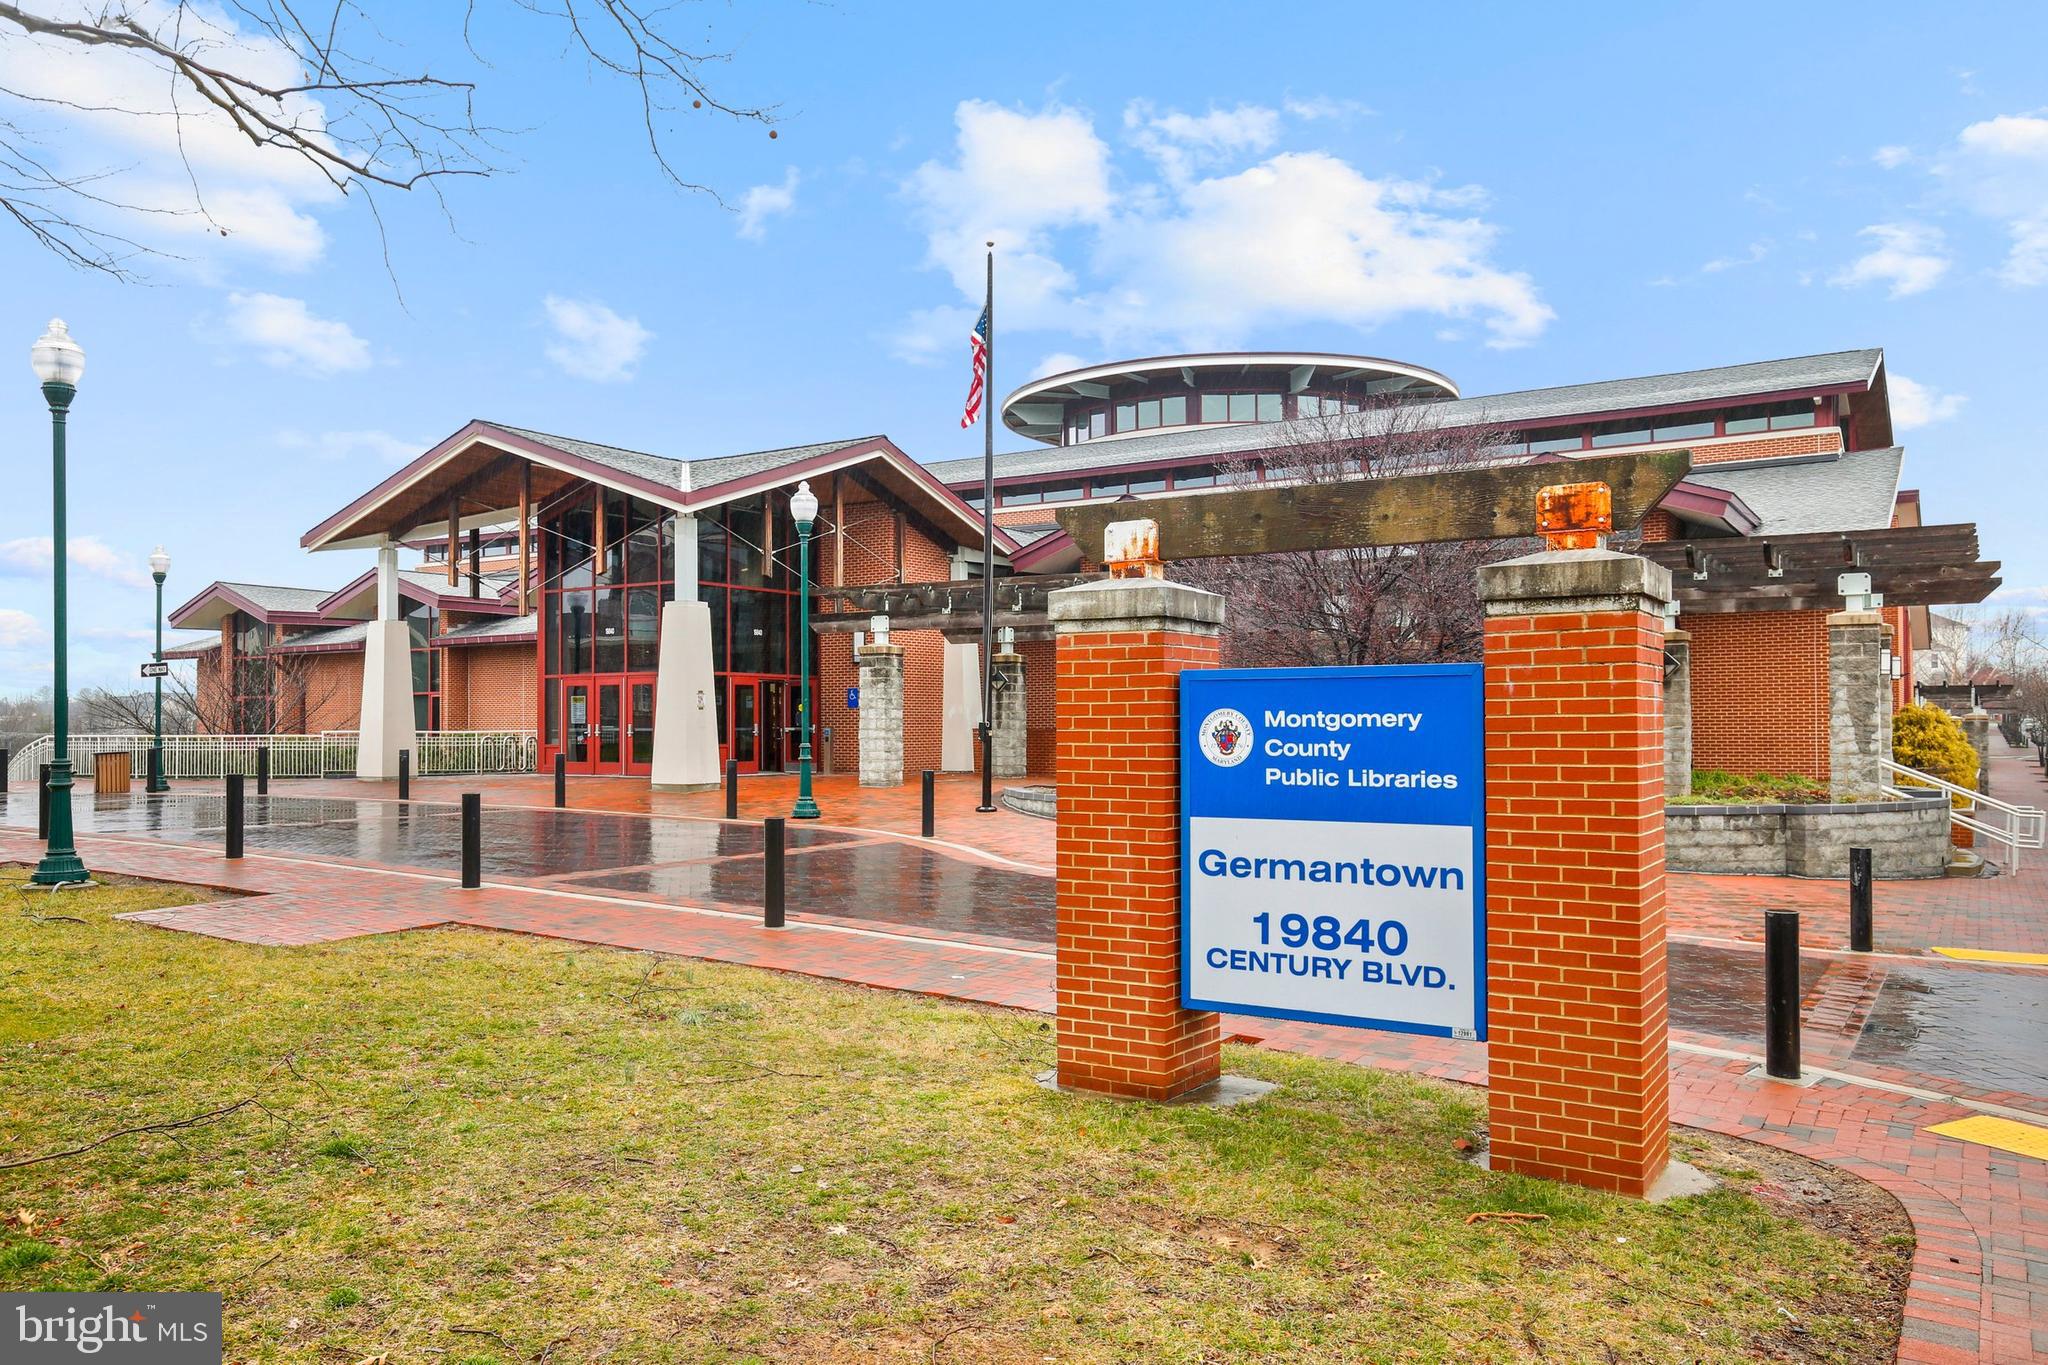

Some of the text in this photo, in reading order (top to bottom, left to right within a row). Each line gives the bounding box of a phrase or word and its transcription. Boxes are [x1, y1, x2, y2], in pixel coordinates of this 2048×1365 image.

[1264, 710, 1423, 732] Montgomery
[1264, 738, 1352, 761] County
[1265, 767, 1458, 789] Public Libraries
[1198, 849, 1464, 891] Germantown
[1253, 911, 1408, 956] 19840
[1206, 947, 1456, 990] CENTURY BLVD.
